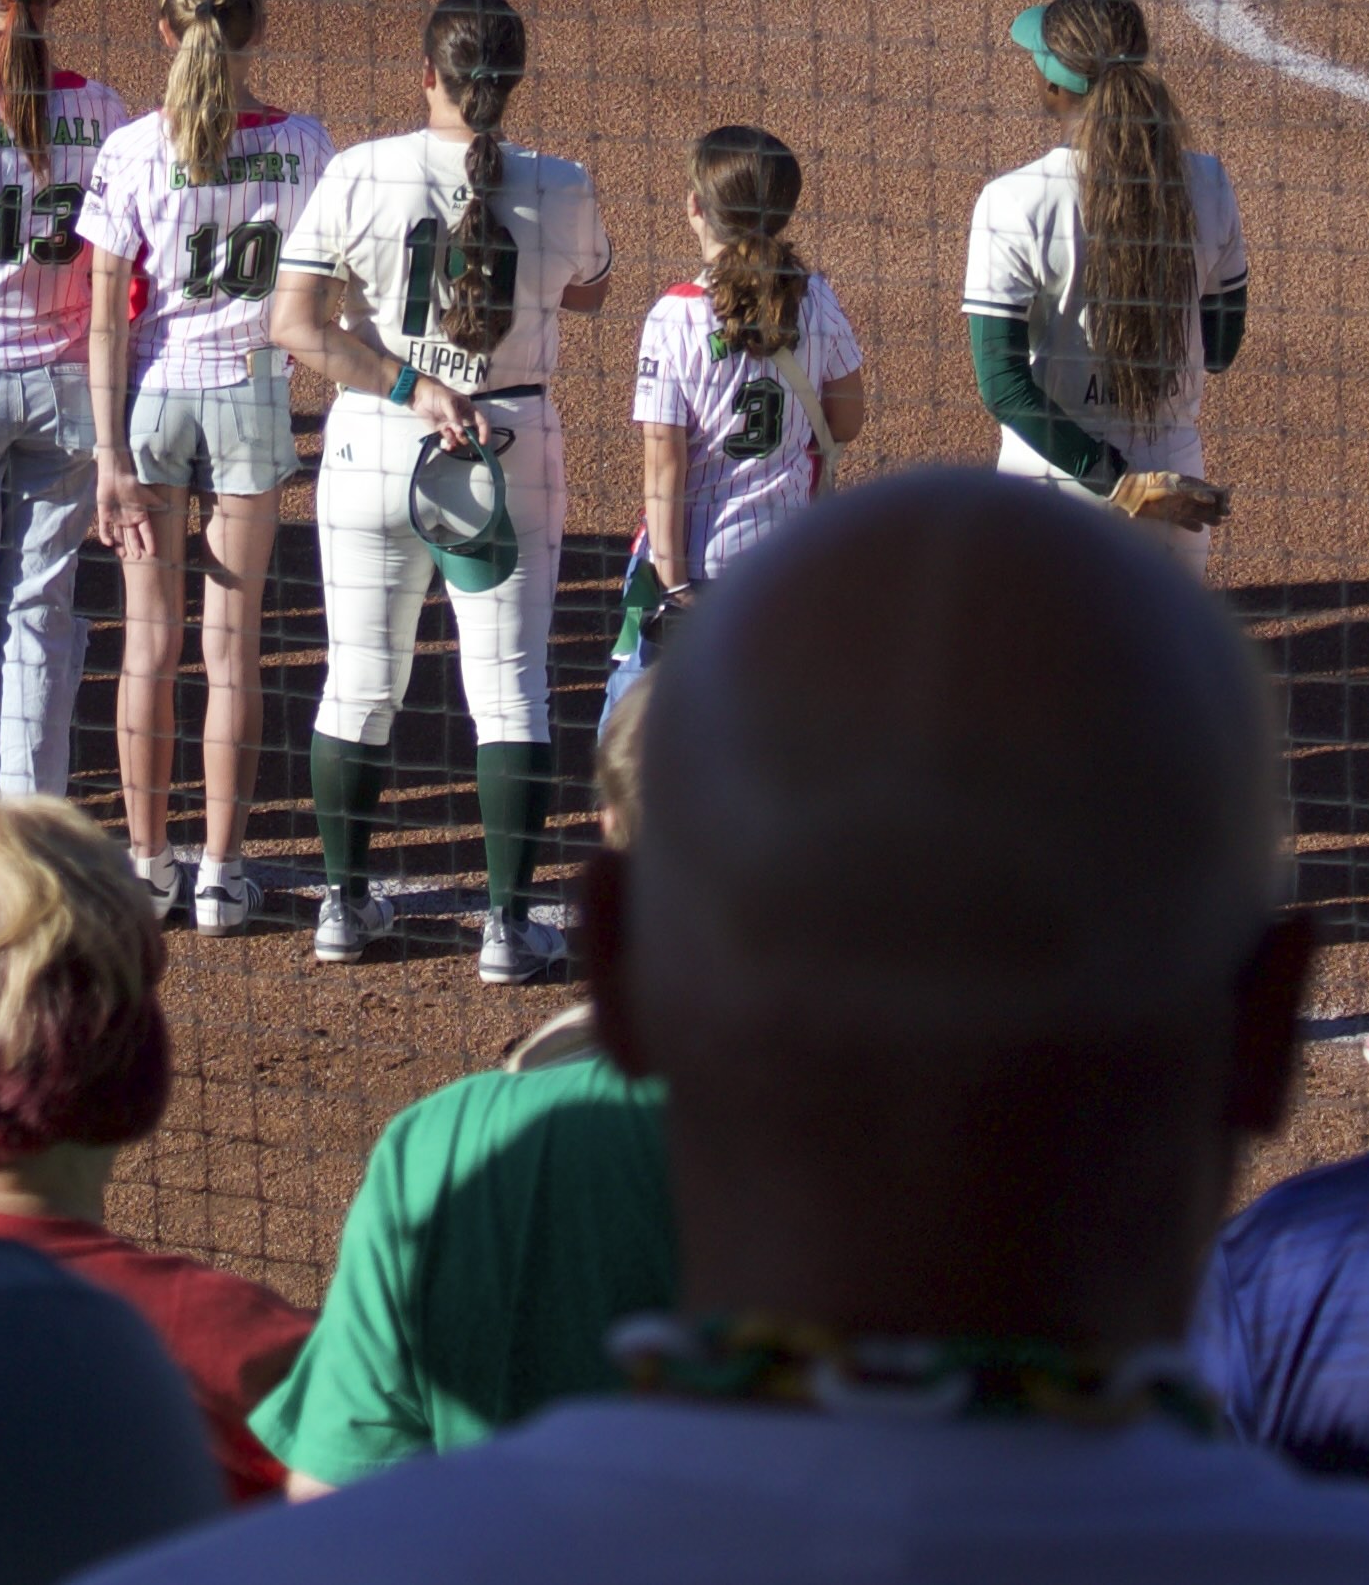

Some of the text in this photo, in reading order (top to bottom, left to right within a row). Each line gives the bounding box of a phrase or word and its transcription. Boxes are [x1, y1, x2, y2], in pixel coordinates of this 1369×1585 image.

[182, 219, 283, 302] 10
[408, 340, 490, 384] FLIPPEN
[723, 377, 785, 460] 3
